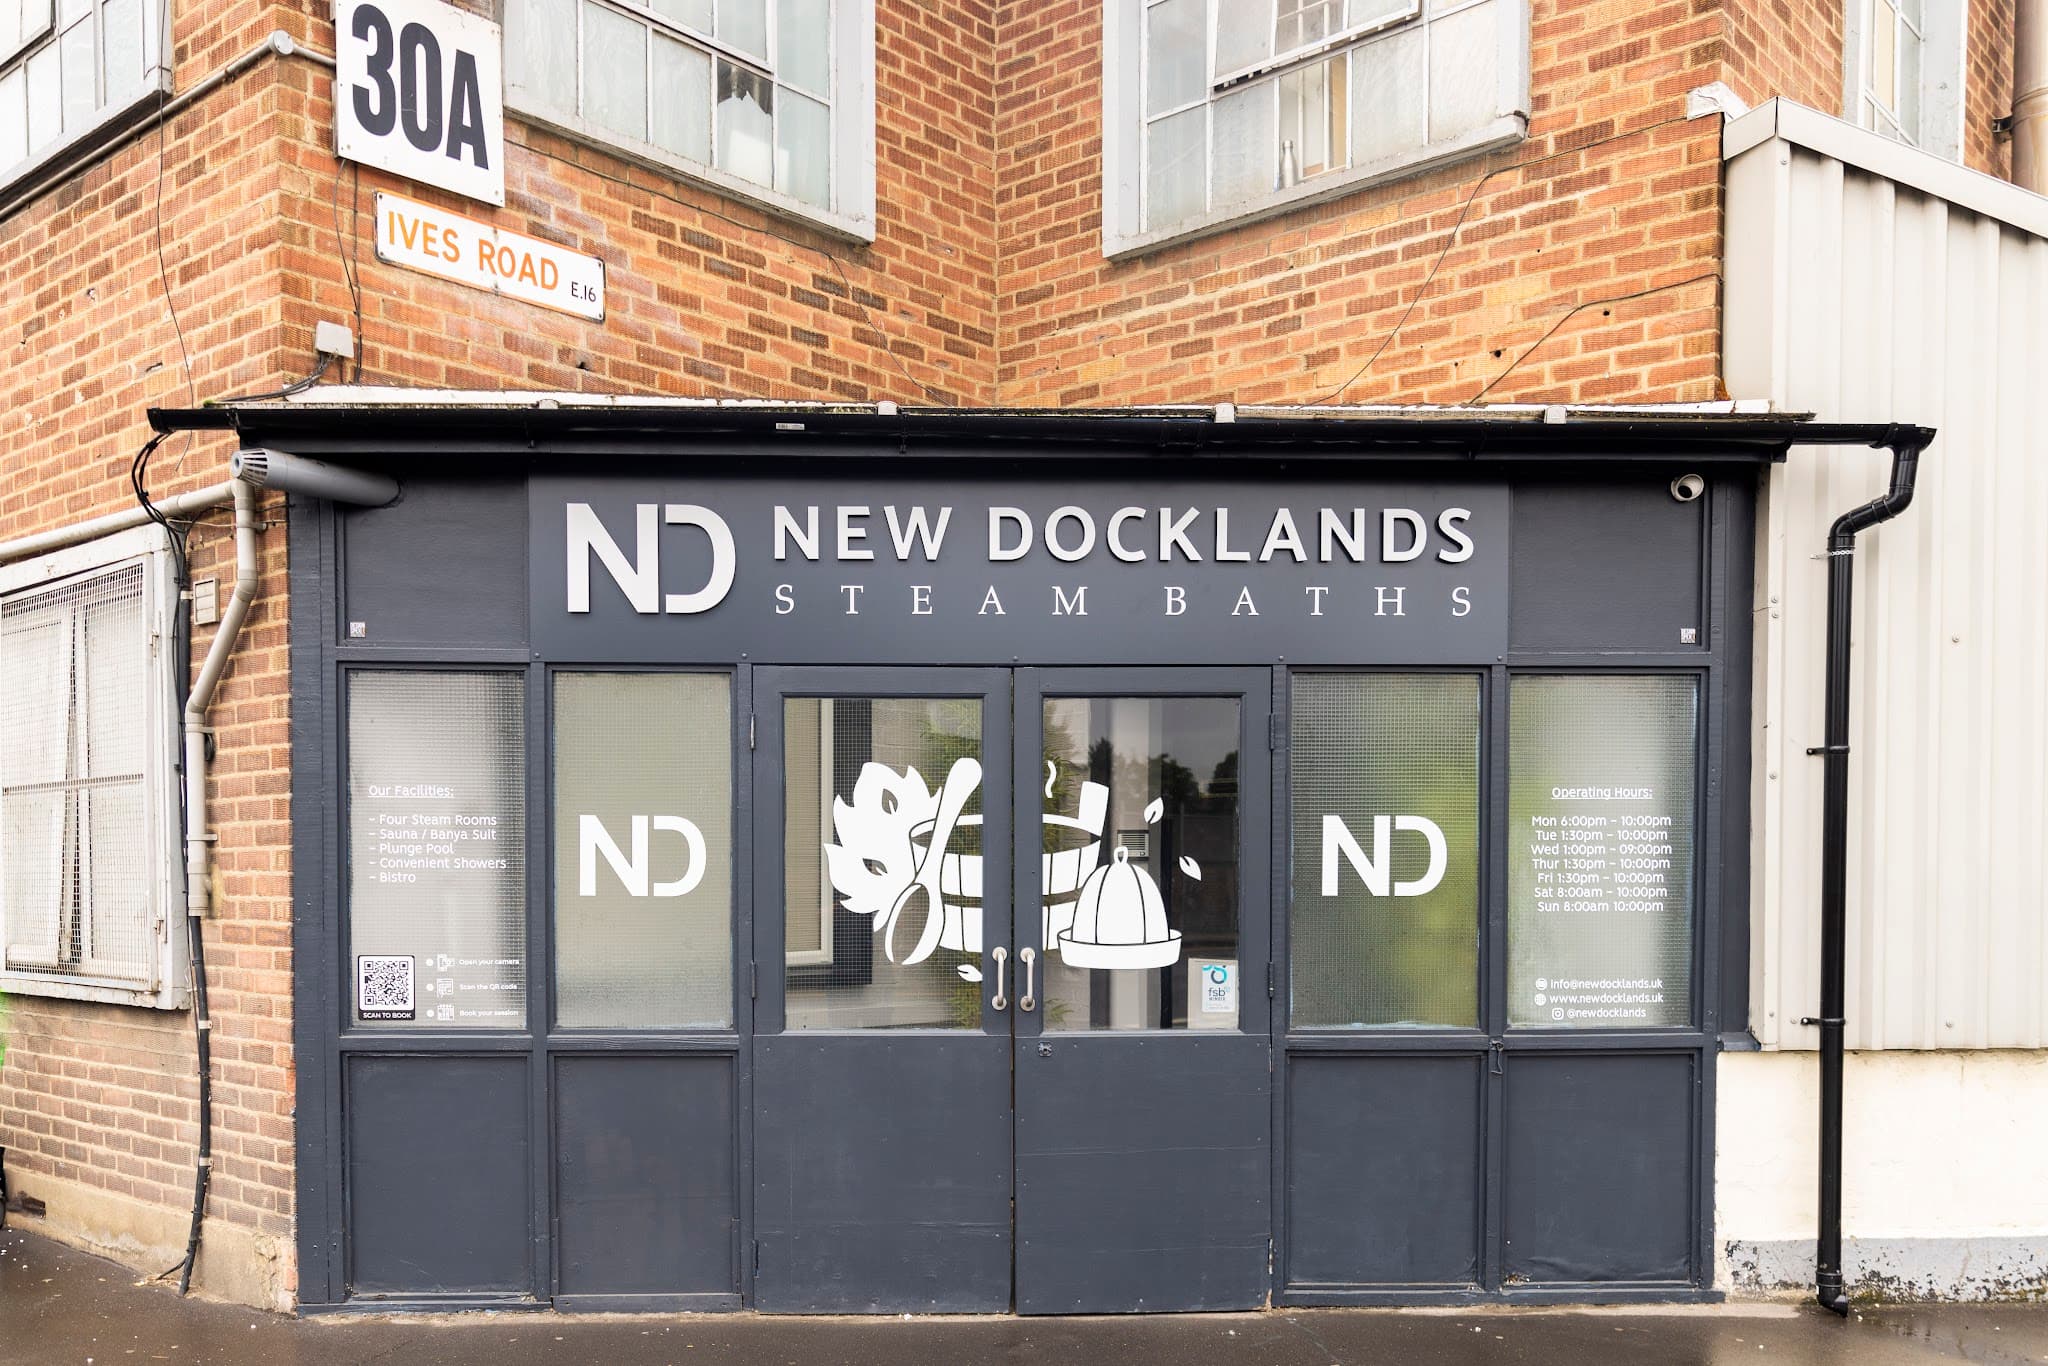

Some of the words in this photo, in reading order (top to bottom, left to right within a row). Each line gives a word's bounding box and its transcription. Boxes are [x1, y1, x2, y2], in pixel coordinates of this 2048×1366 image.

[352, 3, 489, 170] 30A
[388, 211, 460, 263] IVES
[478, 238, 558, 290] ROAD
[774, 505, 952, 561] NEW
[988, 505, 1475, 564] DOCKLANDS
[566, 503, 736, 614] ND
[774, 584, 1088, 616] STEAM
[1164, 585, 1472, 617] BATHS
[368, 785, 391, 798] Our
[395, 785, 455, 798] Facilities:
[1552, 787, 1610, 800] Operating
[1615, 787, 1653, 799] Hours:
[379, 814, 408, 825] Four
[412, 814, 451, 825] Steam
[455, 815, 497, 826] Rooms
[1532, 816, 1557, 826] Mon
[1561, 816, 1607, 828] 6:00pm
[1621, 816, 1672, 828] 10:00pm
[380, 829, 418, 840] Sauna
[430, 829, 468, 842] Banya
[472, 829, 496, 840] Suit
[1536, 830, 1557, 840] Tue
[1561, 830, 1603, 842] 1:30pm
[1617, 830, 1668, 842] 10:00pm
[380, 843, 422, 856] Plunge
[426, 843, 454, 854] Pool
[580, 815, 707, 896] ND
[1322, 815, 1447, 896] ND
[1531, 844, 1559, 855] Wed
[1563, 845, 1605, 856] 1:00pm
[1619, 845, 1672, 857] 09:00pm
[380, 858, 449, 869] Convenient
[454, 858, 506, 869] Showers
[1532, 859, 1559, 869] Thur
[1564, 859, 1605, 871] 1:30pm
[1620, 859, 1671, 871] 10:00pm
[380, 872, 416, 883] Bistro
[1538, 873, 1553, 883] Fri
[1558, 873, 1600, 885] 1:30pm
[1614, 873, 1664, 885] 10:00pm
[1534, 887, 1553, 898] Sat
[1557, 887, 1602, 898] 8:00am
[1617, 887, 1668, 899] 10:00pm
[1537, 902, 1559, 912] Sun
[1564, 902, 1609, 912] 8:00am
[1614, 902, 1664, 913] 10:00pm
[1551, 978, 1663, 990] info@newdocklands.uk
[1208, 987, 1225, 997] fsb
[1550, 993, 1663, 1004] www.newdocklands.uk
[1567, 1007, 1646, 1019] @newdocklands
